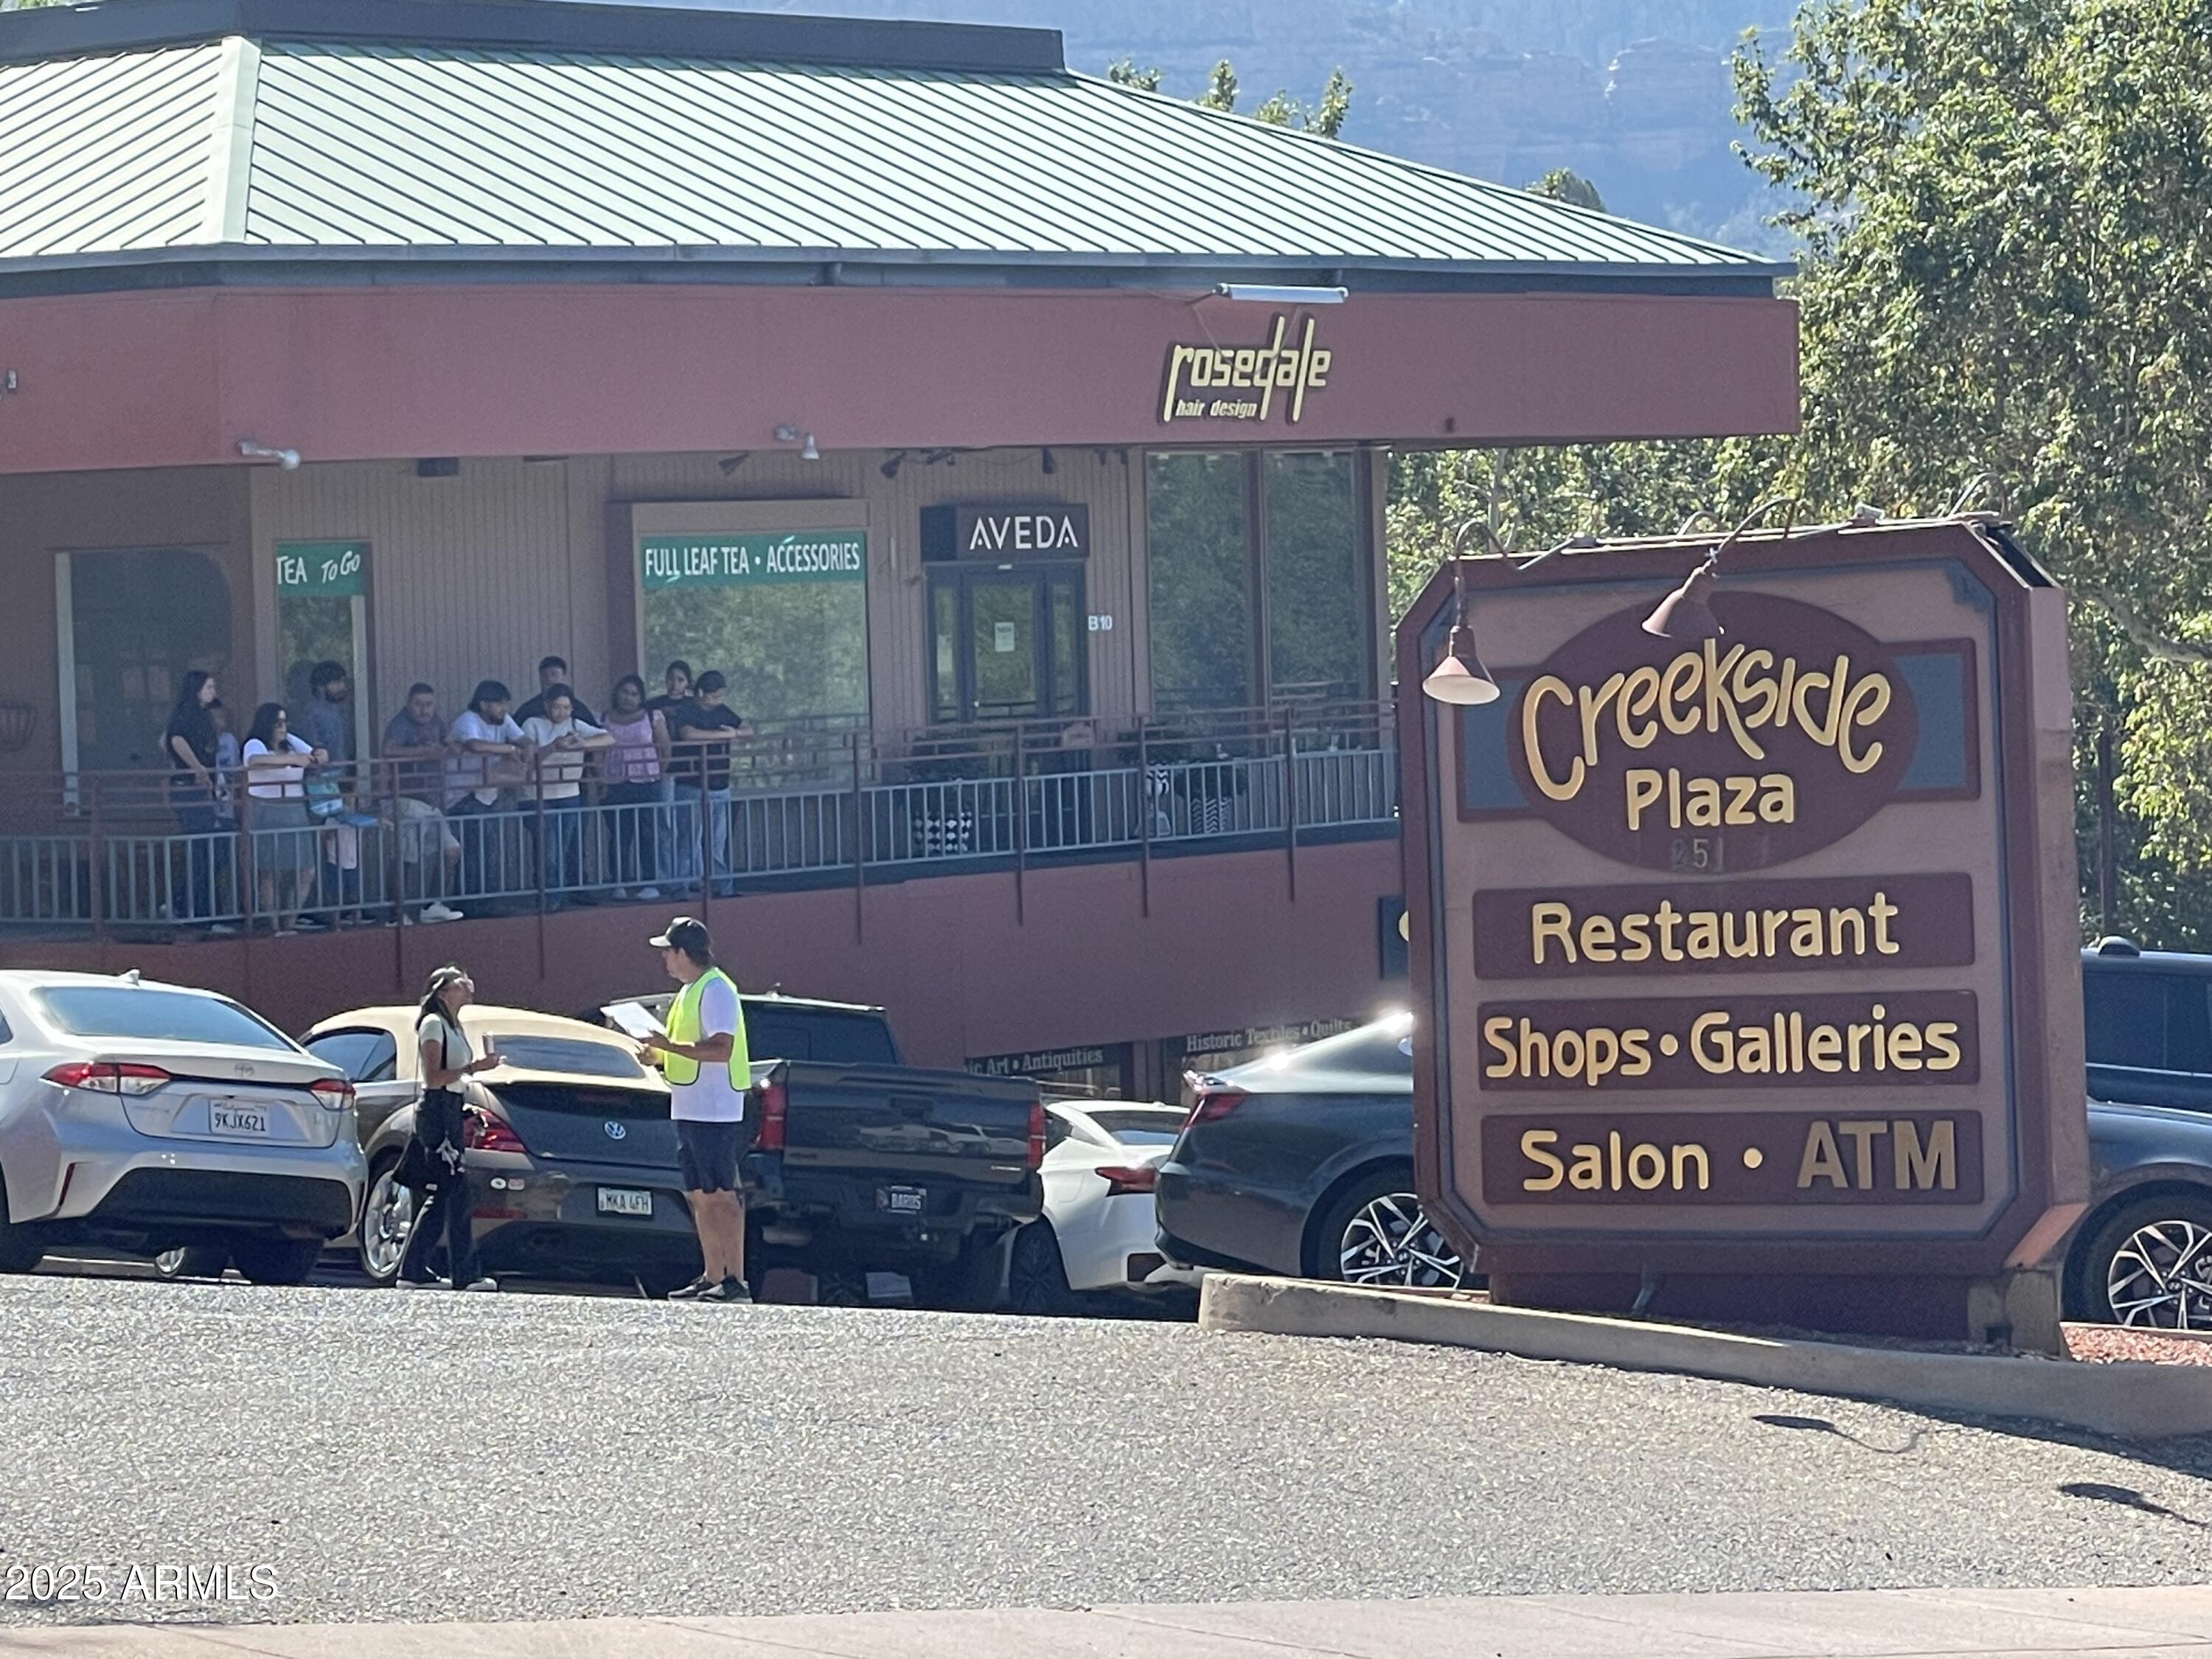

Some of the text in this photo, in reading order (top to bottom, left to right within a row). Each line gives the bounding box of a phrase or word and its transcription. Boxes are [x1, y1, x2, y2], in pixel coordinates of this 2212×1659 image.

[1163, 316, 1332, 422] rosedale
[1175, 398, 1258, 419] hair design
[969, 515, 1079, 551] AVEDA
[276, 554, 308, 585] TEA
[644, 542, 861, 577] FULL LEAF TEA ACCESSORIES
[1087, 614, 1113, 631] B10
[1523, 638, 1892, 801] Creekside
[1626, 768, 1795, 831] Plaza
[1531, 891, 1901, 964] Restaurant
[1186, 1029, 1242, 1054] Historic
[1484, 1003, 1961, 1087] Shops Galleries
[987, 1057, 1009, 1074] Art
[1021, 1047, 1104, 1072] Antiquities
[214, 1111, 267, 1132] 9KJX621
[1520, 1119, 1958, 1192] Salon ATM
